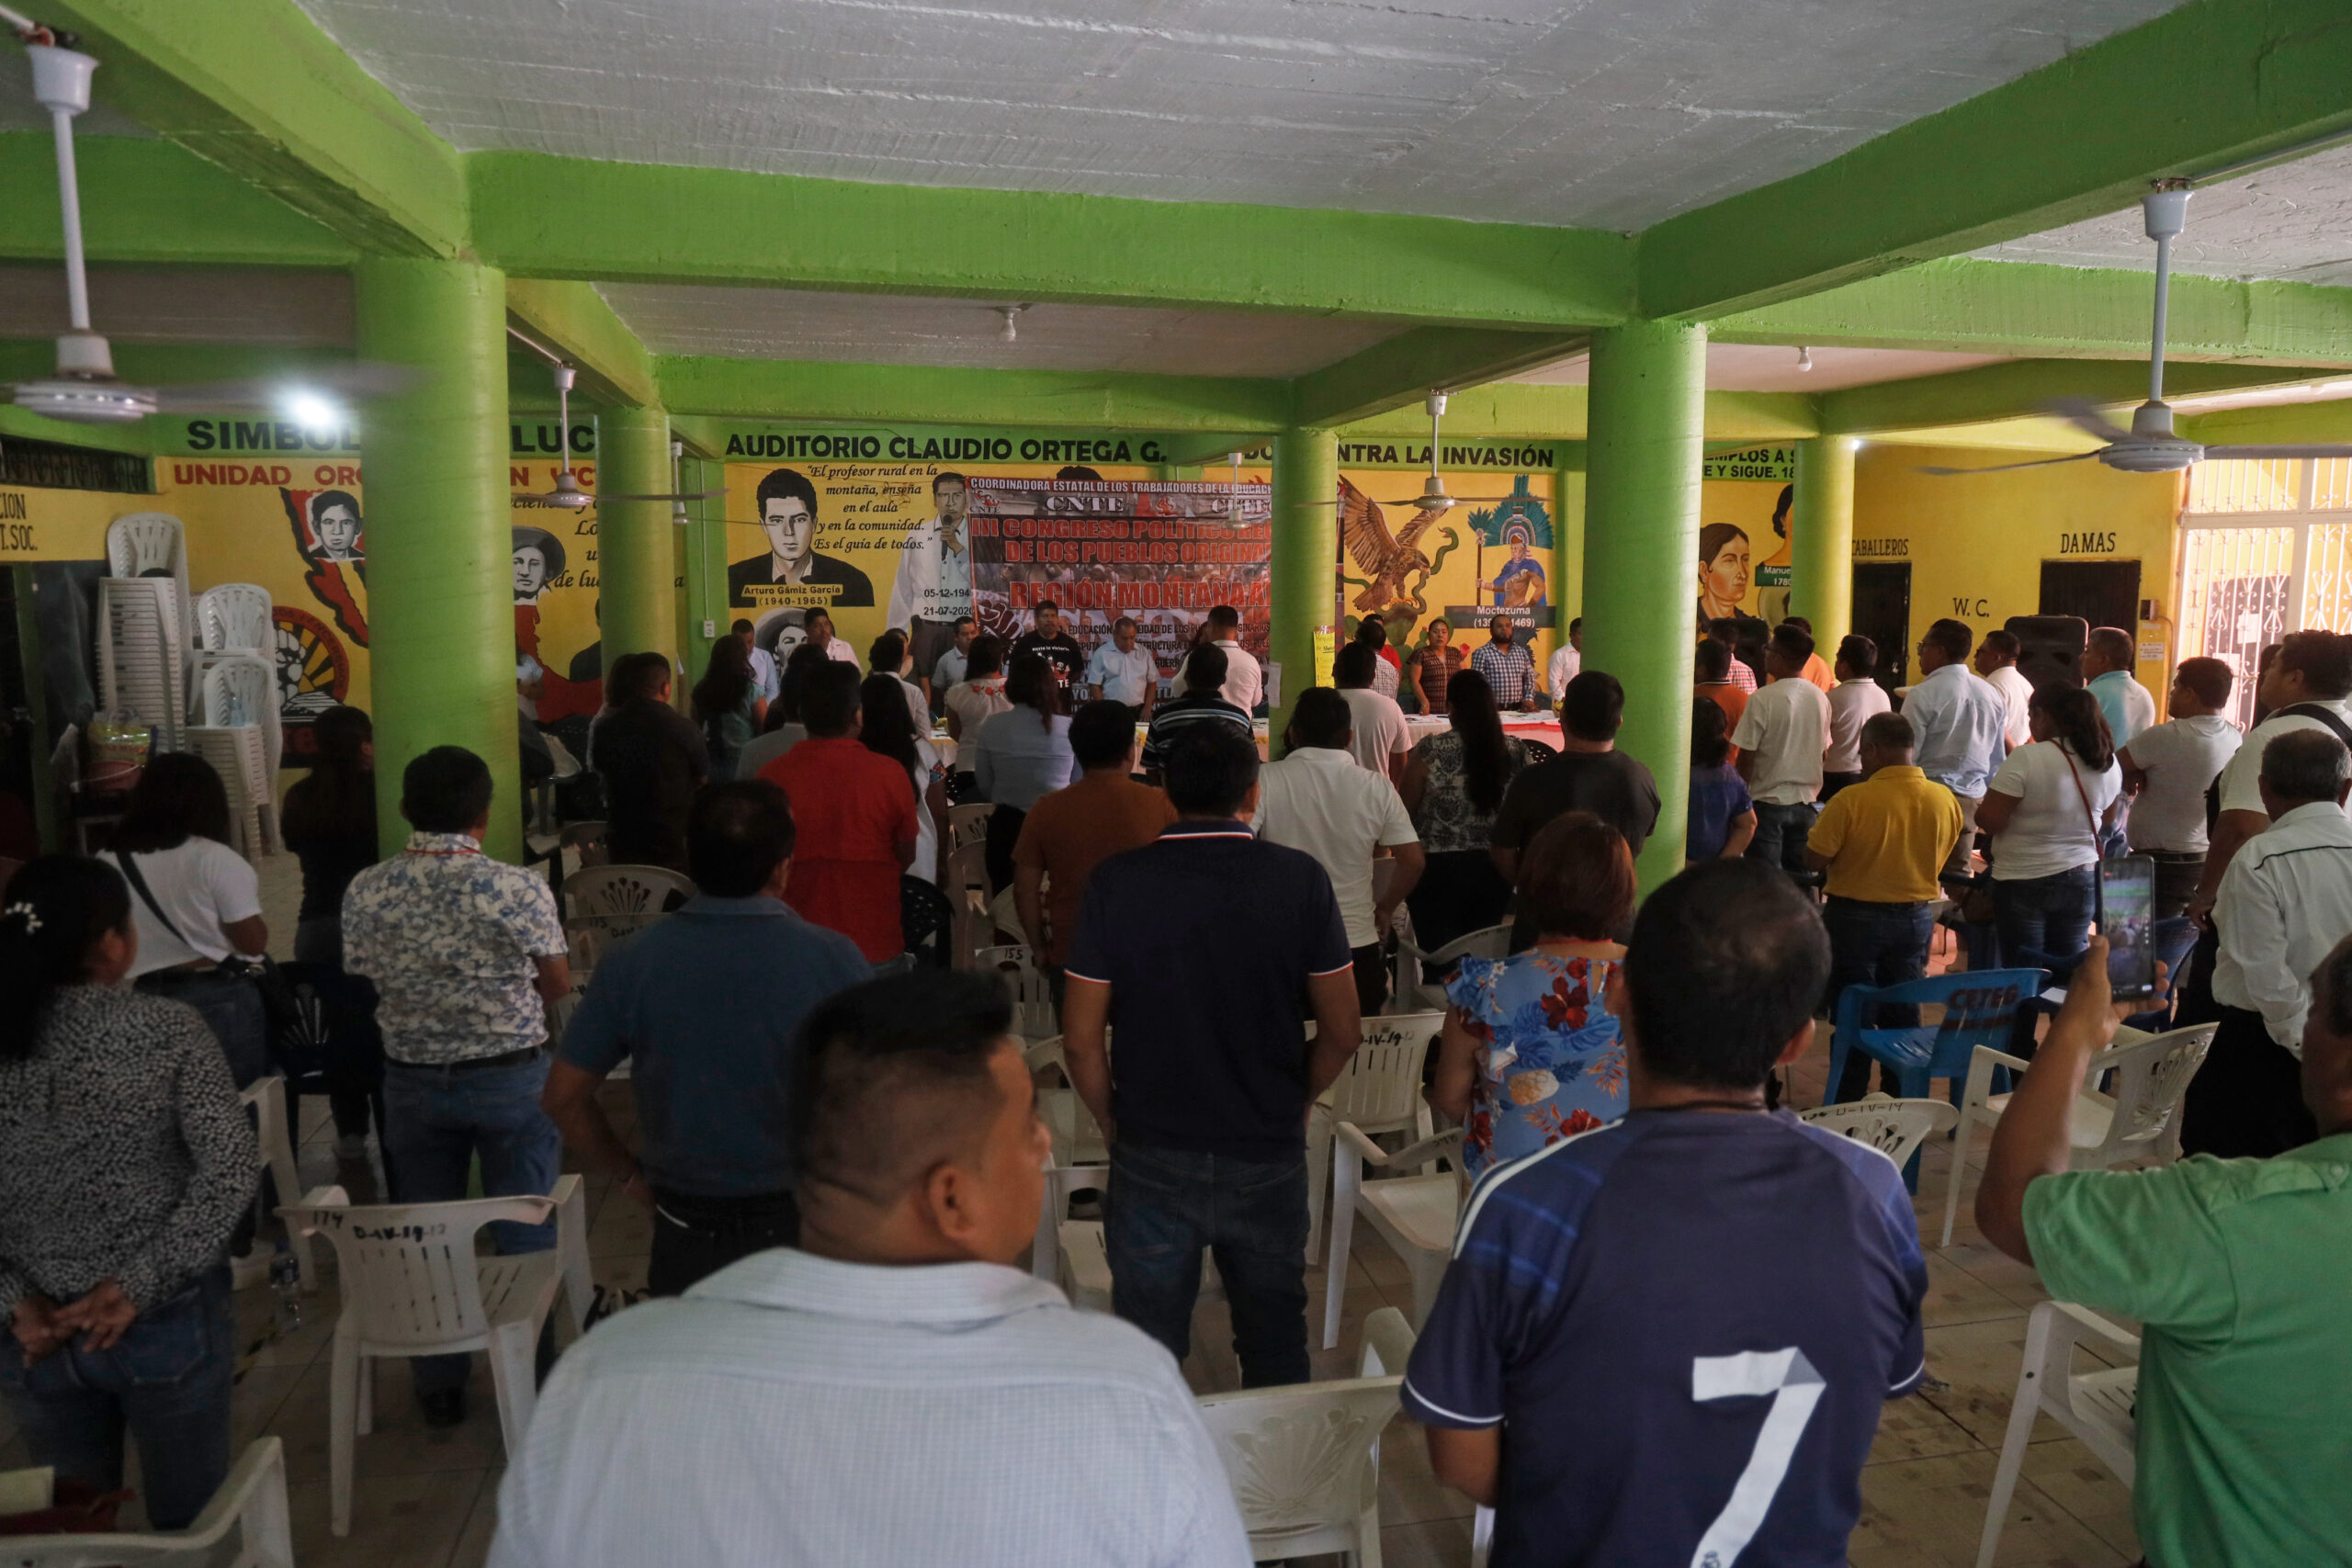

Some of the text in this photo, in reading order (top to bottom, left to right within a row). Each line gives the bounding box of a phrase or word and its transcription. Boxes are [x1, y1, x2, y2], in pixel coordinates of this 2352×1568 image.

[725, 434, 1168, 463] AUDITORIO CLAUDIO ORTEGA G.
[1406, 445, 1433, 465] LA
[1442, 444, 1554, 468] INVASIÓN
[174, 464, 362, 486] UNIDAD OR
[828, 464, 876, 479] profesor
[877, 464, 907, 476] rural
[909, 467, 923, 476] en
[925, 463, 938, 476] la
[1717, 465, 1726, 477] Y
[1730, 465, 1777, 479] SIGUE.
[826, 484, 922, 496] montaña, enseña
[970, 477, 1050, 491] COORDINADORA
[1053, 480, 1095, 492] ESTATAL
[1096, 481, 1109, 493] DE
[1111, 481, 1128, 493] LOS
[1131, 481, 1204, 494] TRABAJADORES
[1205, 483, 1217, 494] DE
[1218, 483, 1230, 494] LA
[842, 502, 899, 513] en el aula
[1046, 496, 1125, 513] CNTE
[816, 518, 925, 534] y en la comunidad.
[970, 517, 999, 537] III
[1002, 518, 1129, 539] CONGRESO
[1133, 517, 1235, 540] POLÍTICO
[814, 537, 831, 549] Es
[832, 536, 843, 549] el
[845, 537, 871, 553] guía
[874, 536, 888, 549] de
[2060, 532, 2116, 553] DAMAS
[1005, 540, 1035, 563] DE
[1036, 541, 1079, 564] LOS
[1081, 541, 1179, 564] PUEBLOS
[554, 570, 574, 588] de
[743, 586, 775, 594] Arturo
[1009, 577, 1114, 609] REGIÓN
[1116, 578, 1247, 609] MONTAÑA
[758, 596, 828, 605] (1940-1965)
[1952, 597, 1989, 617] W. C.
[1476, 605, 1532, 615] Moctezuma
[1691, 1346, 1827, 1568] 7
